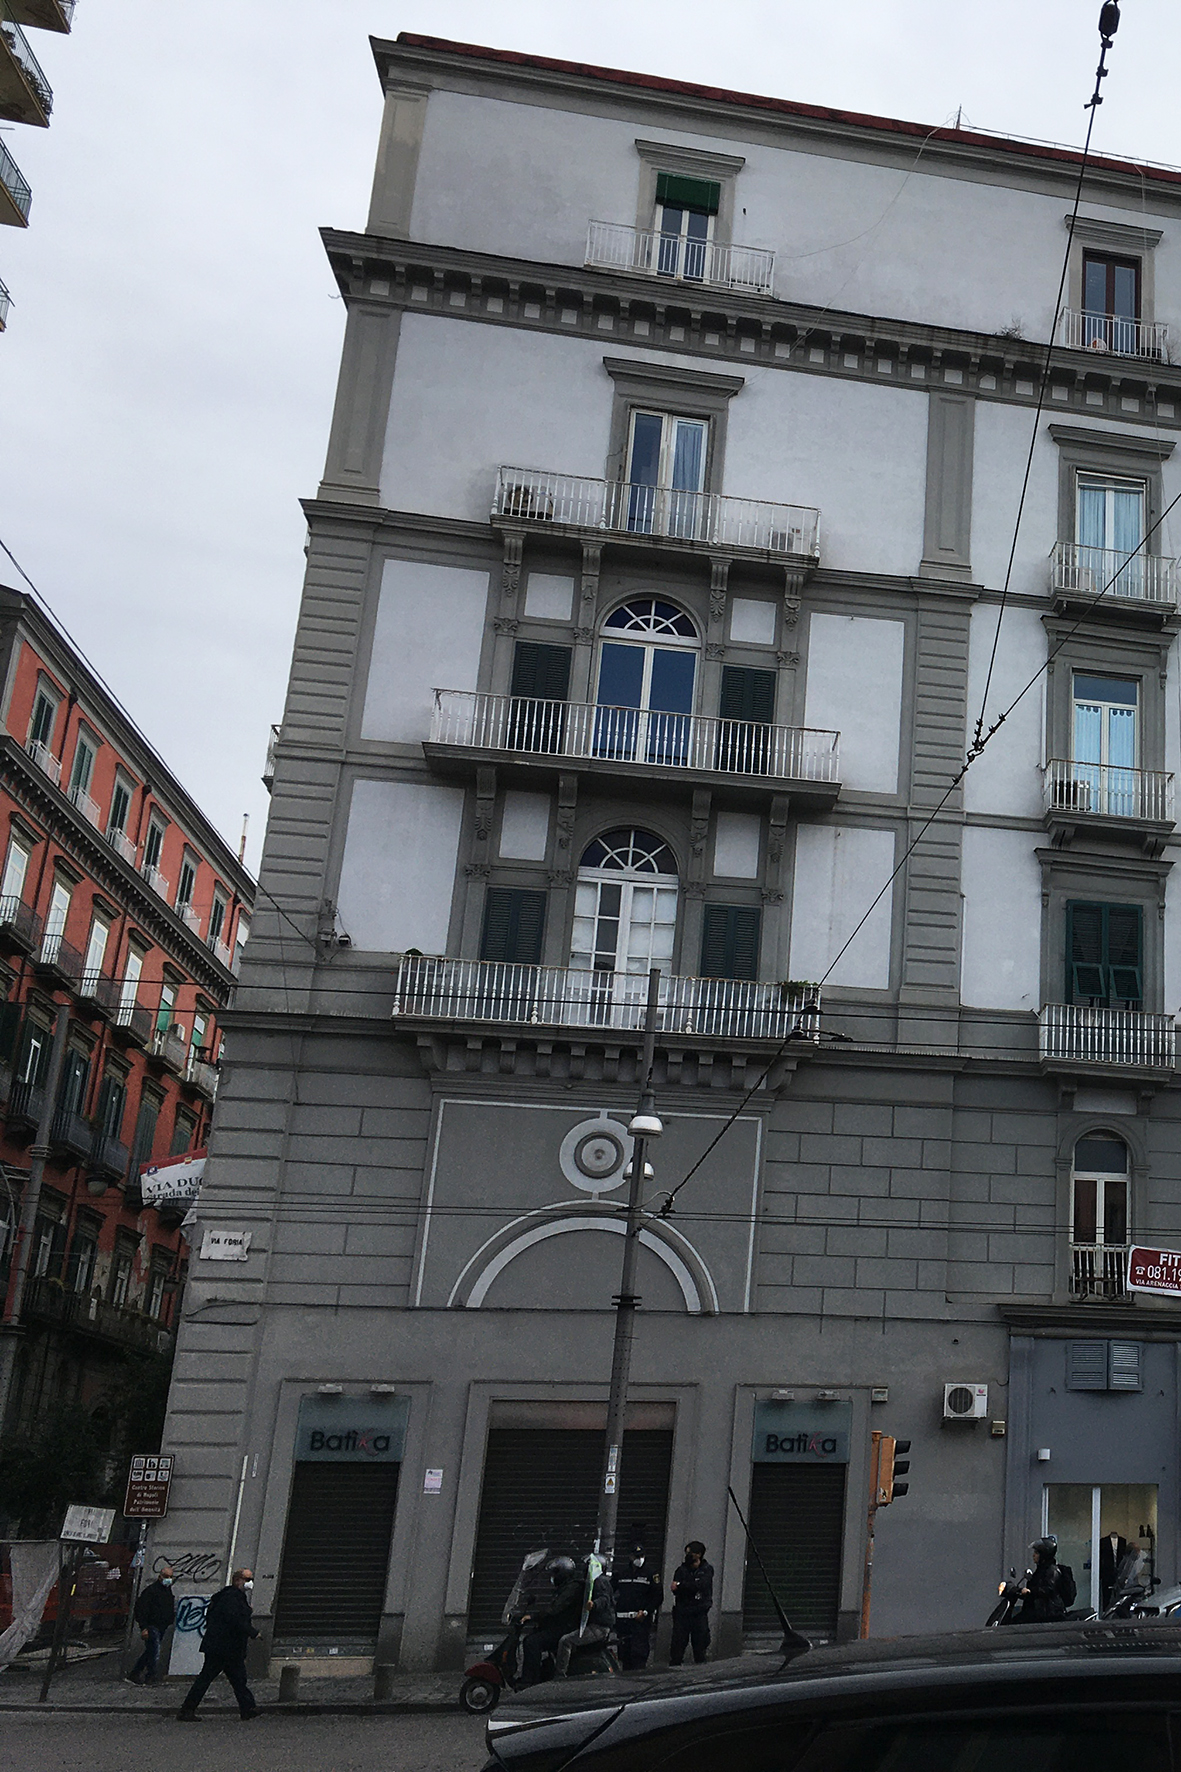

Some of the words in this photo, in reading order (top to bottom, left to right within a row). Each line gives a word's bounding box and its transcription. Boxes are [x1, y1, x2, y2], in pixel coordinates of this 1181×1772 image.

[146, 1181, 173, 1194] VIA
[224, 1238, 243, 1246] FORIA
[1135, 1278, 1145, 1286] VIA
[1146, 1280, 1179, 1289] ARENACCIA
[310, 1428, 391, 1457] Batika
[766, 1430, 837, 1458] Batika
